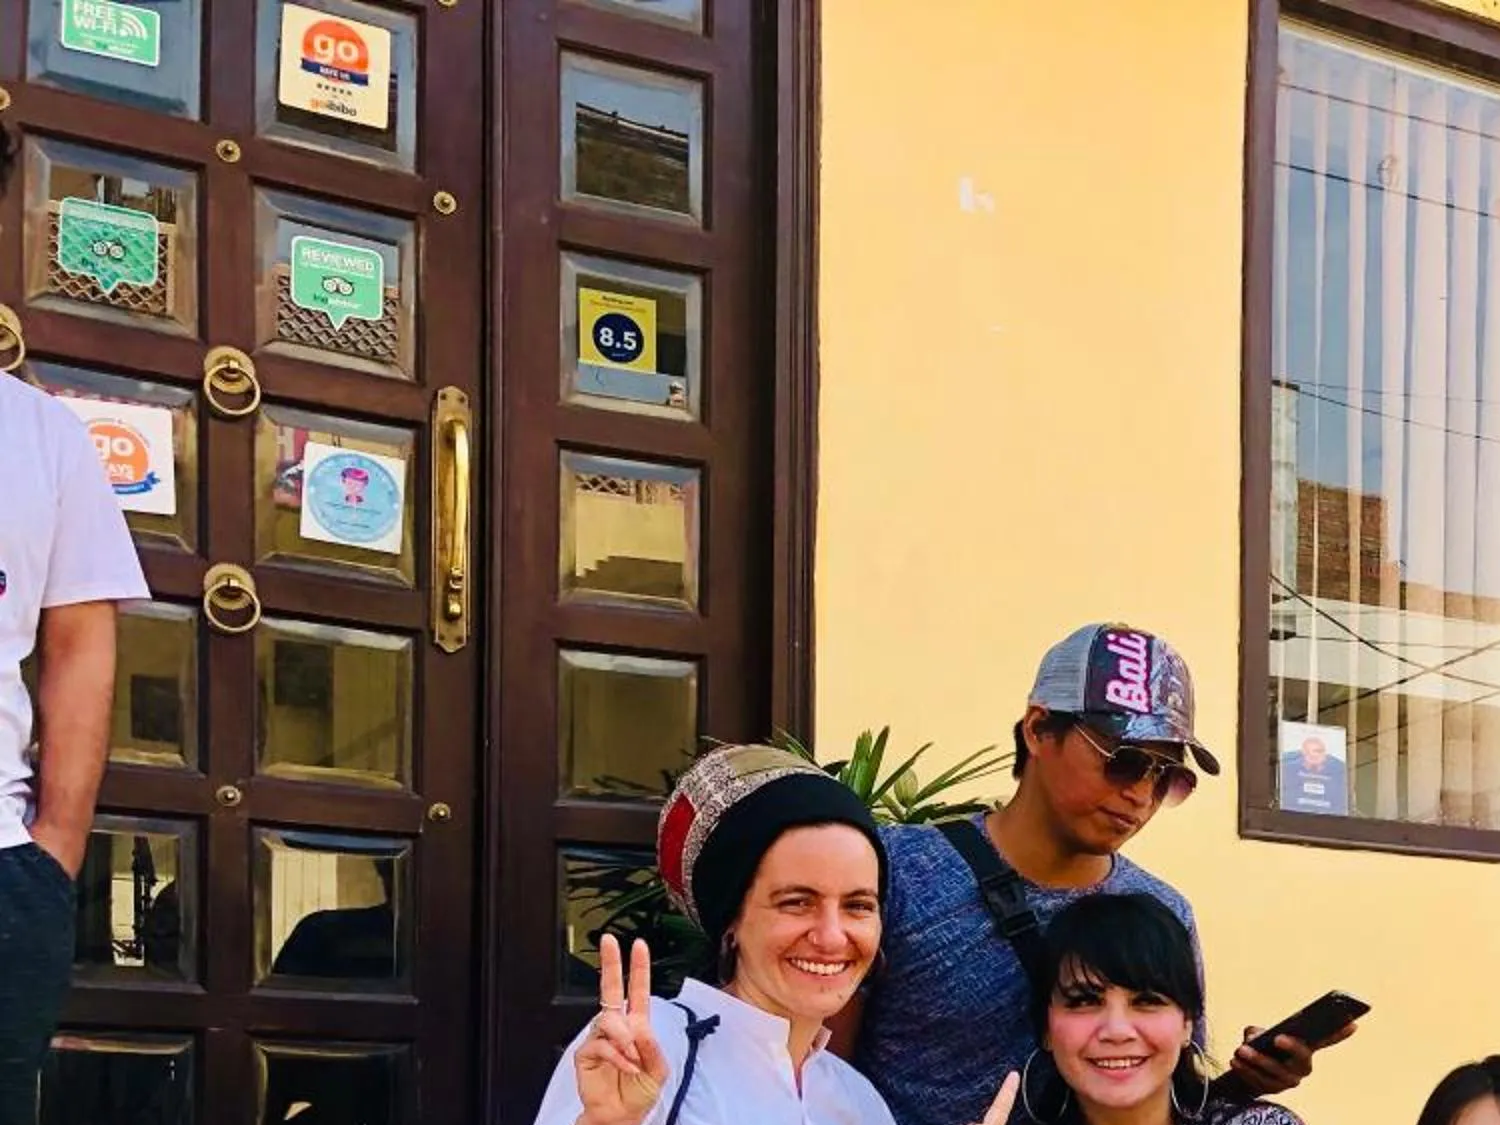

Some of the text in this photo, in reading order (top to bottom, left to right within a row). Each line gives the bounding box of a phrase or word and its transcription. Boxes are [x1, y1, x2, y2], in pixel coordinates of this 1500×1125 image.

[313, 33, 359, 65] go
[302, 247, 375, 273] REVIEWED
[600, 326, 637, 351] 8.5
[1105, 632, 1149, 713] Bali
